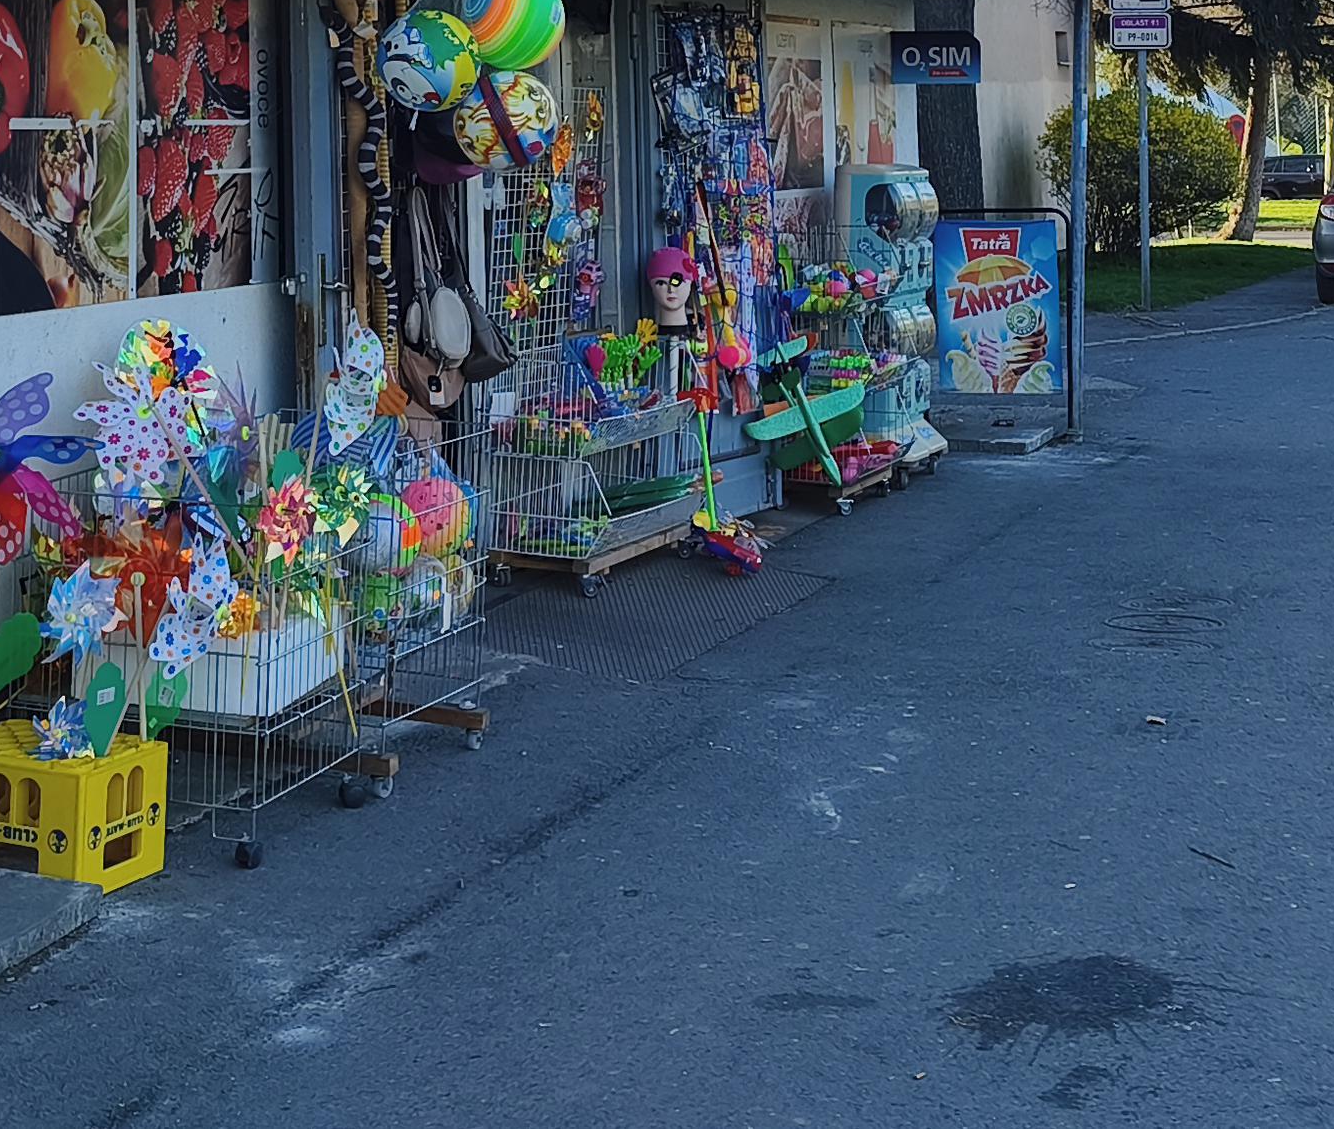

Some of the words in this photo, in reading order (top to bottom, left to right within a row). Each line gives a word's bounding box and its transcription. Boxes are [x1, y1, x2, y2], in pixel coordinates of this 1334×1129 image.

[1121, 18, 1148, 27] OBLAST
[1127, 32, 1158, 42] P9-0014
[928, 46, 971, 67] SIM
[255, 48, 269, 130] ovoce
[970, 235, 1011, 250] Tatra
[946, 272, 1051, 321] ZMRZKA
[105, 814, 144, 838] CLUB-MATE
